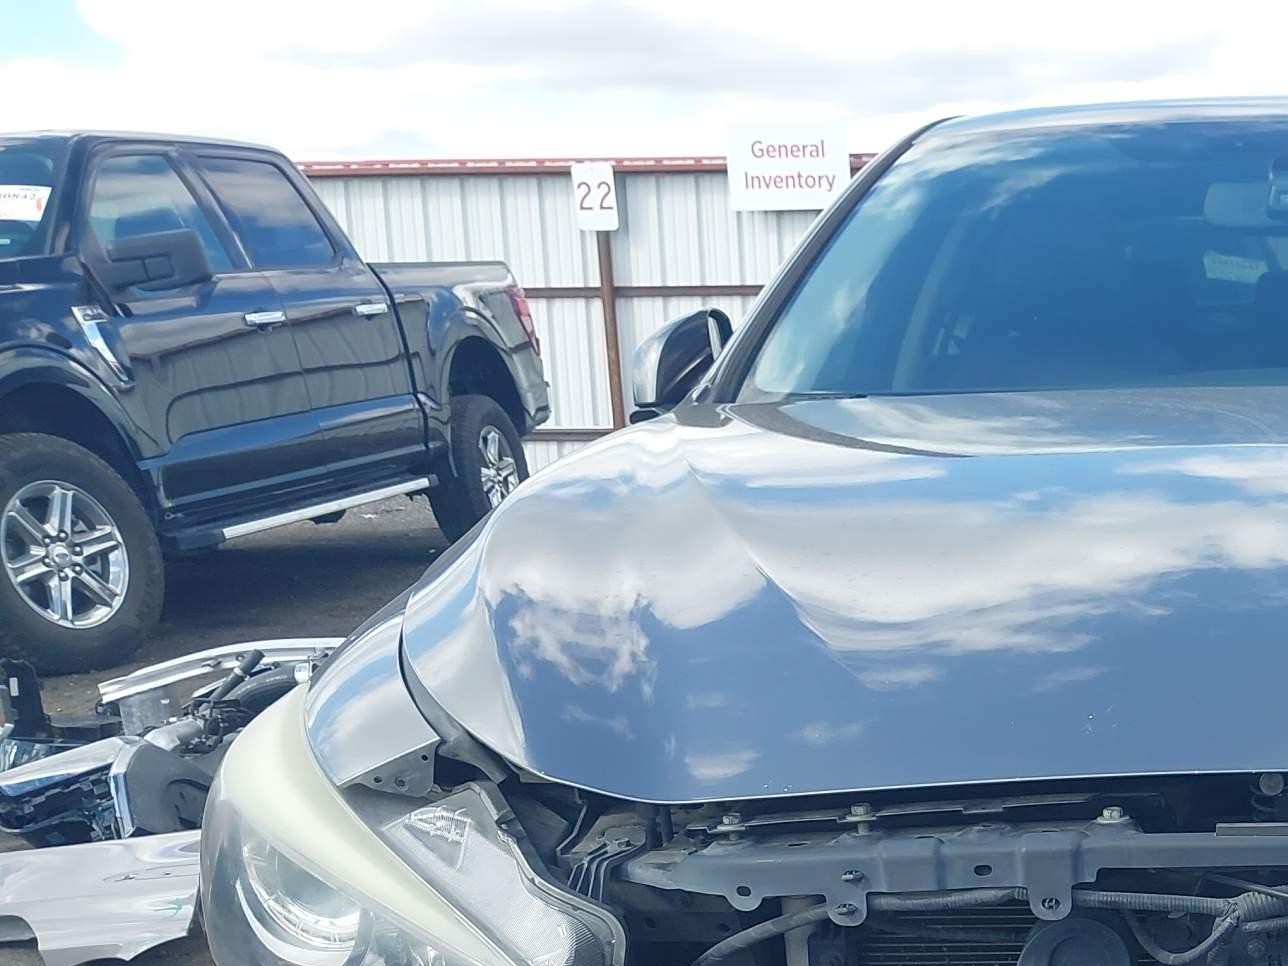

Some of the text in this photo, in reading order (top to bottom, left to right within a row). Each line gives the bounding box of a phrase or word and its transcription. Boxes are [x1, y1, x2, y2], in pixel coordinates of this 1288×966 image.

[751, 139, 826, 159] General
[744, 170, 837, 193] Inventory
[576, 181, 614, 210] 22
